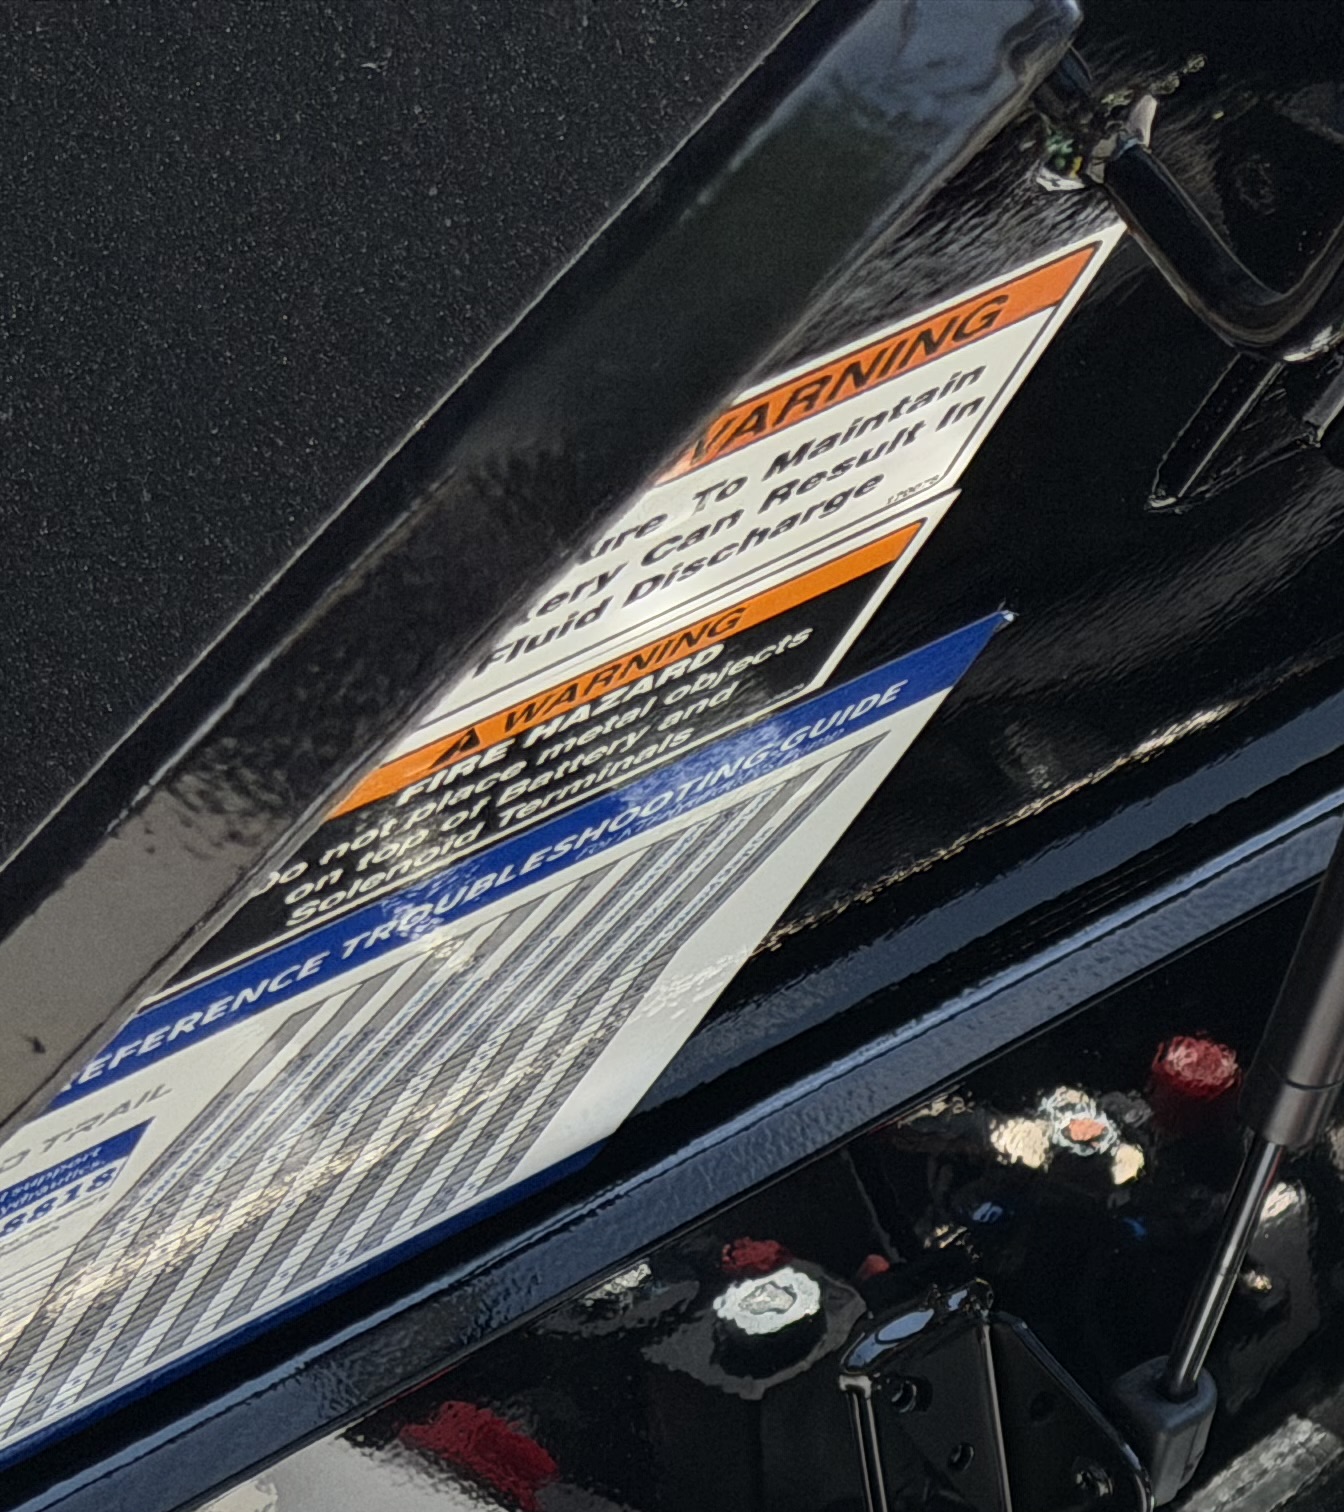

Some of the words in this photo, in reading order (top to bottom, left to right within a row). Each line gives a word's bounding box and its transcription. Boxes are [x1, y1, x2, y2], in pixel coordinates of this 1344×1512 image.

[641, 509, 744, 566] Can
[759, 421, 924, 513] Result
[936, 396, 985, 430] In
[693, 476, 748, 512] To
[764, 366, 984, 479] Maintain
[474, 597, 611, 677] Fluid
[624, 475, 883, 605] Discharge
[505, 608, 744, 731] WARNING
[284, 868, 343, 905] on
[357, 828, 429, 871] top
[439, 796, 490, 832] of
[497, 725, 650, 806] Battery
[657, 680, 739, 731] and
[319, 817, 398, 865] not
[404, 761, 526, 831] place
[537, 696, 657, 765] metal
[664, 628, 811, 705] objects
[345, 741, 776, 955] TROUBLESHOOTING
[775, 680, 906, 756] GUIDE
[396, 739, 514, 806] FIRE
[525, 644, 723, 747] HAZARD
[288, 823, 483, 925] Solenoid
[500, 728, 693, 826] Terminals
